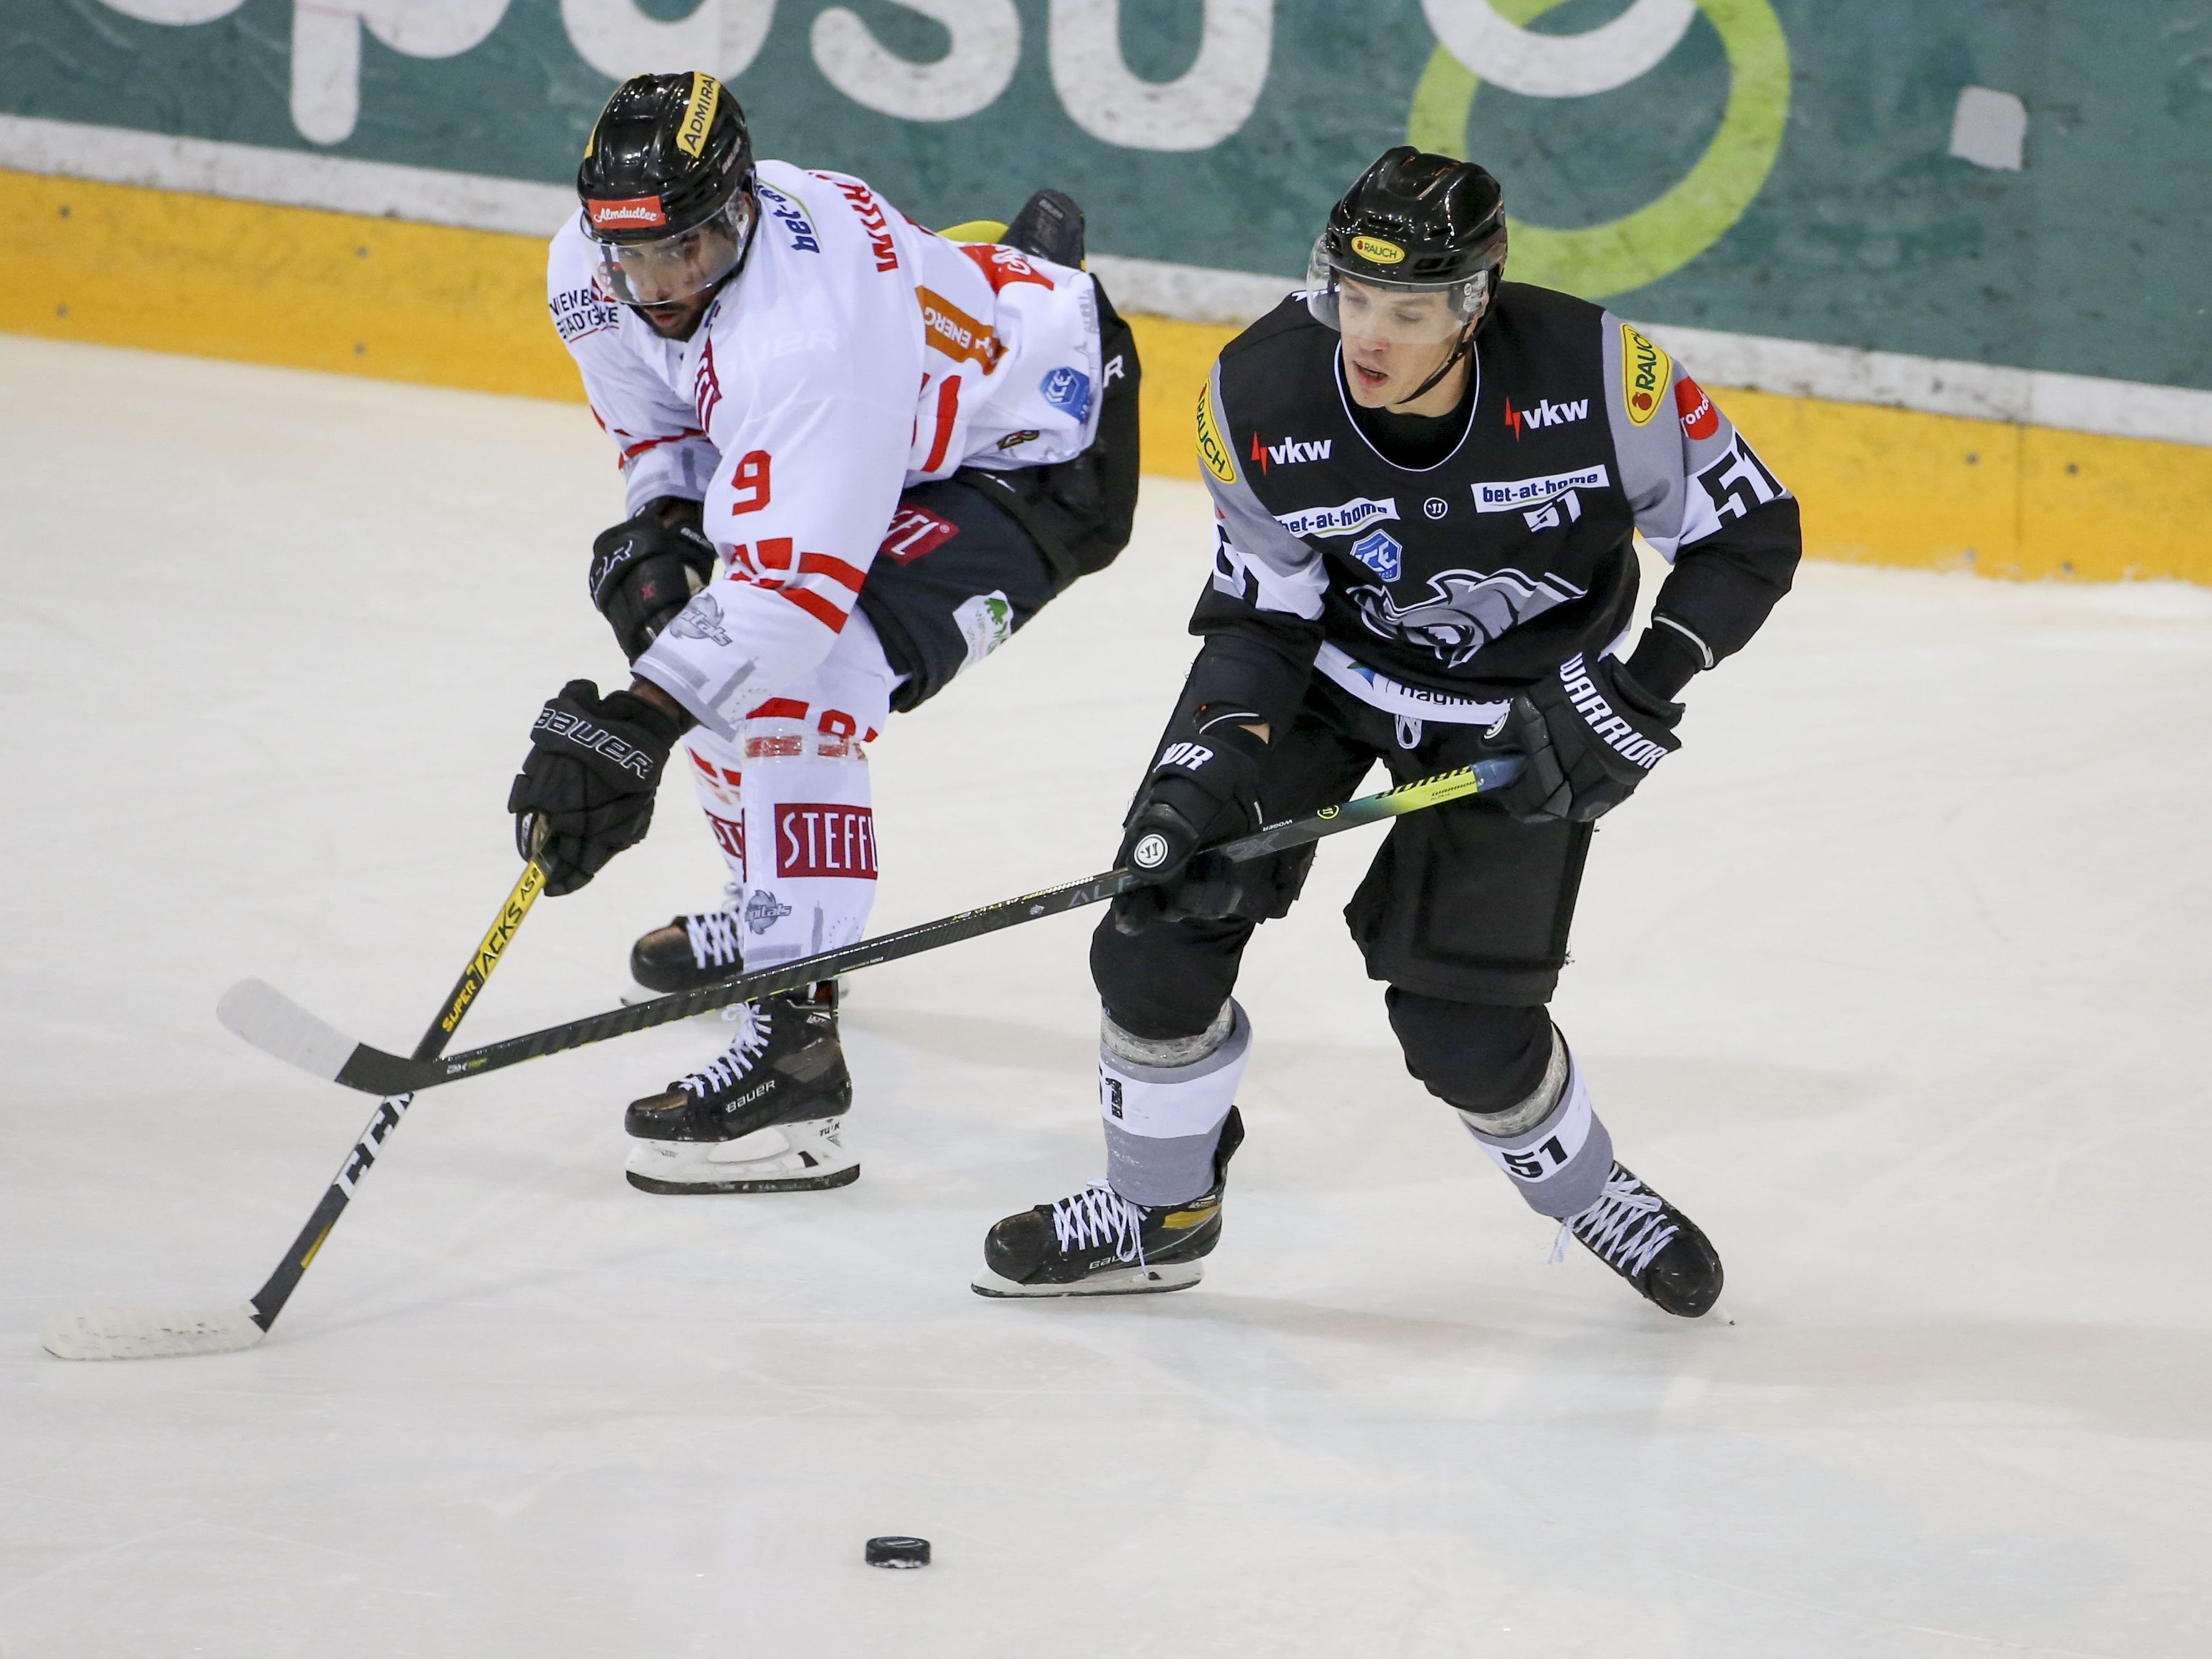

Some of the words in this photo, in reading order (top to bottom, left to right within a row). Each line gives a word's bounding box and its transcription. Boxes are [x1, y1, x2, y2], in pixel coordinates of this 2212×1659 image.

[593, 206, 658, 223] Almdudler
[1364, 243, 1397, 259] RAUCH
[1522, 399, 1589, 430] vkw
[1269, 437, 1332, 465] vkw
[731, 450, 772, 516] 9
[1482, 472, 1599, 503] bet-at-home
[1696, 430, 1784, 529] 51
[1523, 489, 1582, 533] 51
[1559, 651, 1668, 770] WARRIOR
[533, 707, 653, 779] BAUER
[782, 811, 879, 872] STEFFL
[1262, 818, 1293, 832] WOGER
[442, 978, 478, 1032] SUPER
[726, 1079, 777, 1113] BAUER
[1501, 1135, 1568, 1178] 51
